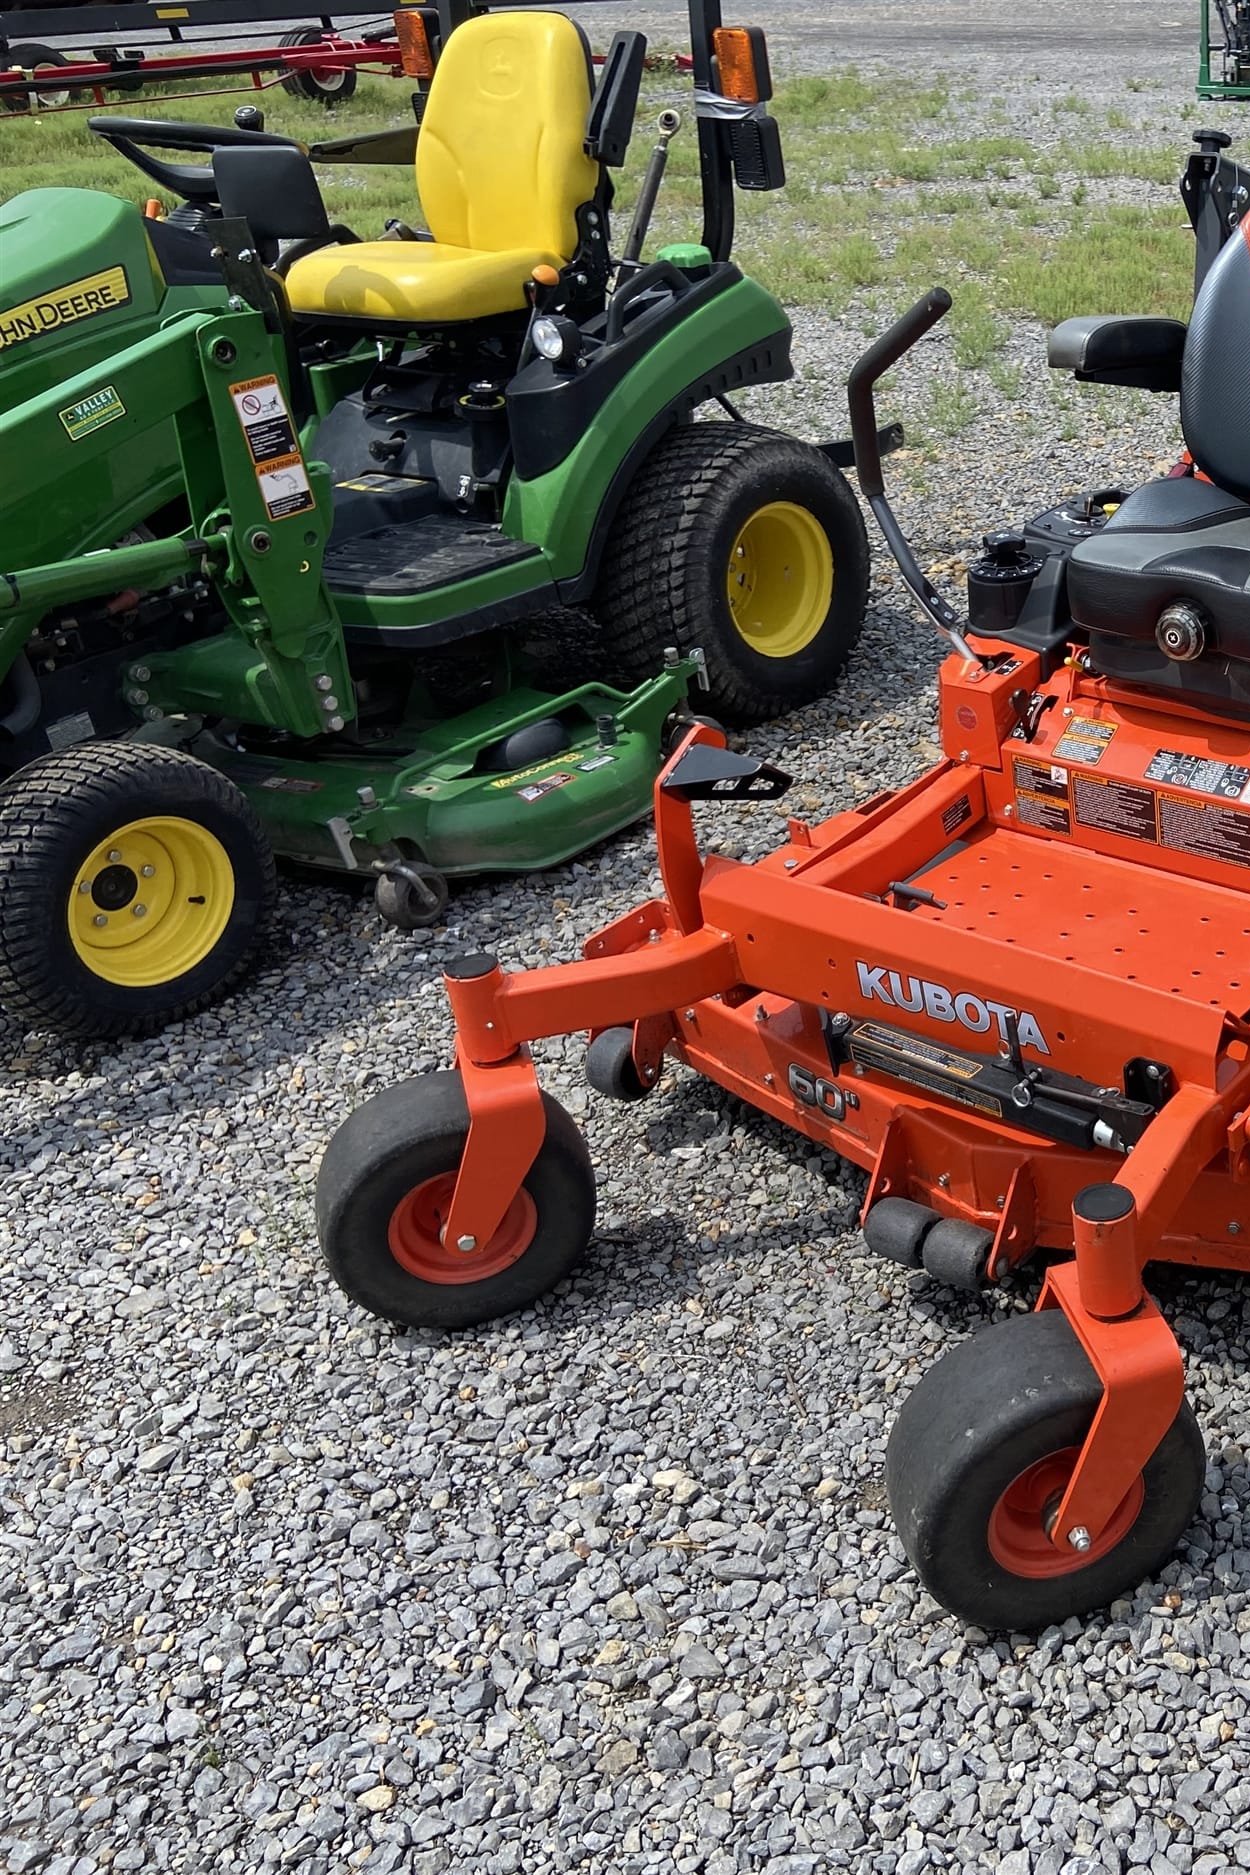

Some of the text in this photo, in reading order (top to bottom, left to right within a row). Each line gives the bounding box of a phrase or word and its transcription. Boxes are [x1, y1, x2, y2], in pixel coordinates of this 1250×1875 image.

[0, 285, 116, 342] HN DEERE
[75, 389, 113, 415] VALLEY
[239, 376, 276, 391] WARNING
[856, 961, 1050, 1055] KUBOTA
